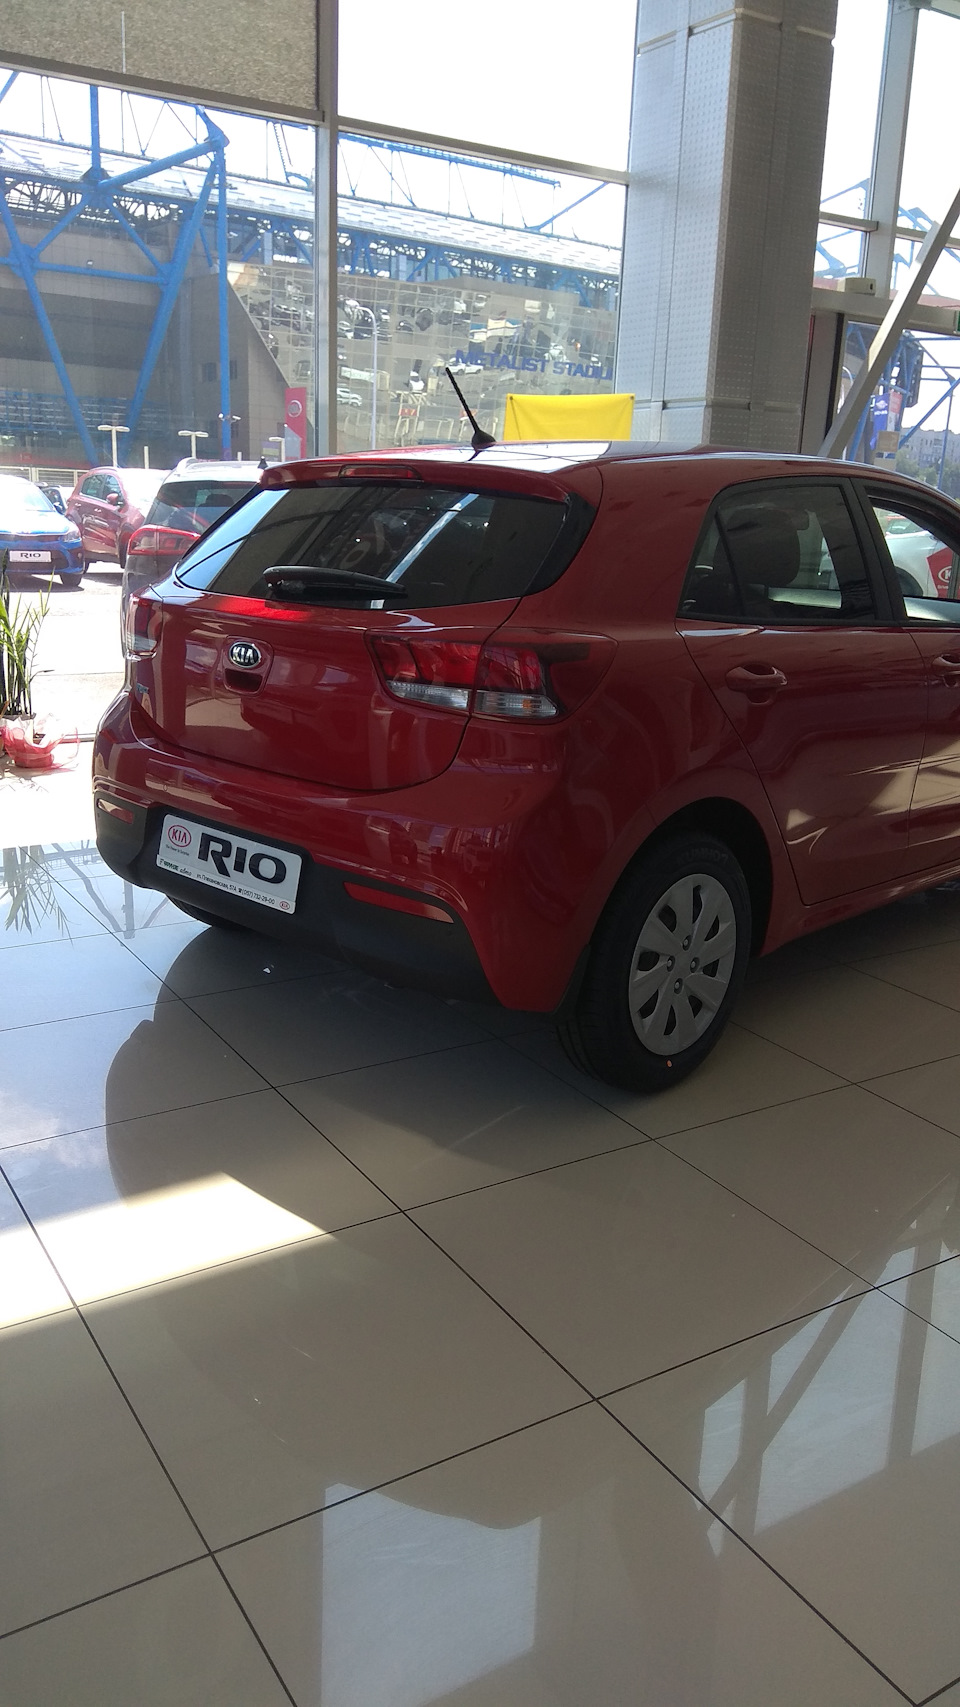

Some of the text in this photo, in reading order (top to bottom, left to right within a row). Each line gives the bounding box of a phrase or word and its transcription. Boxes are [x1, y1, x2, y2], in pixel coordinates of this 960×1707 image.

[455, 349, 550, 372] METALIST
[232, 646, 255, 664] KIA
[171, 828, 187, 844] KIA
[198, 832, 287, 884] RIO
